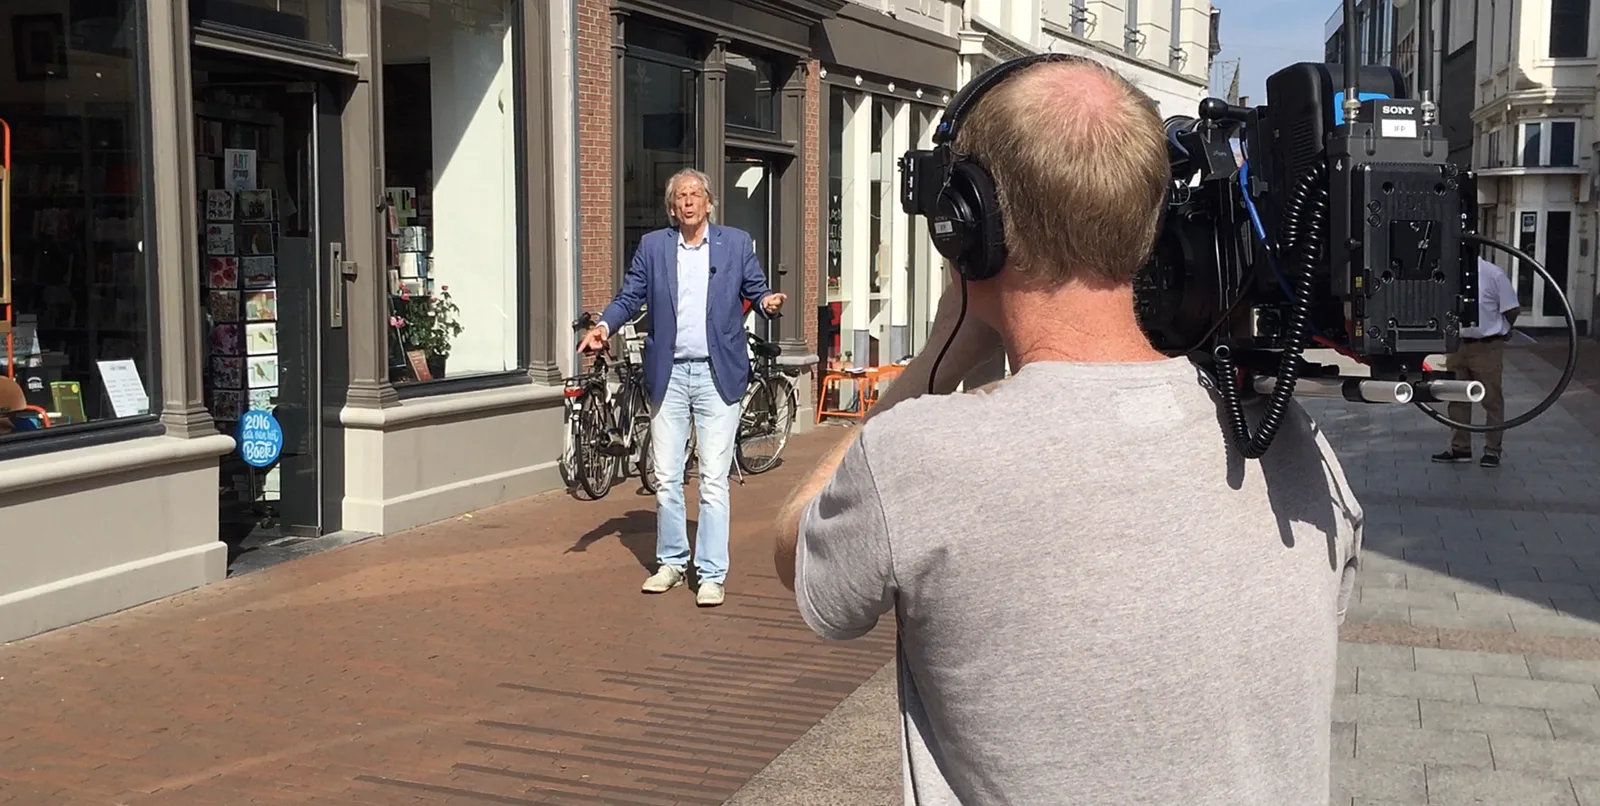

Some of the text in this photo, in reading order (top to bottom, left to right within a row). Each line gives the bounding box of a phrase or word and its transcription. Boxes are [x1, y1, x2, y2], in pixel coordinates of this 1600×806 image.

[1382, 105, 1415, 115] SONY
[233, 152, 249, 169] ART
[1335, 159, 1343, 171] 4
[245, 414, 270, 430] 2016
[243, 440, 277, 460] Boek
